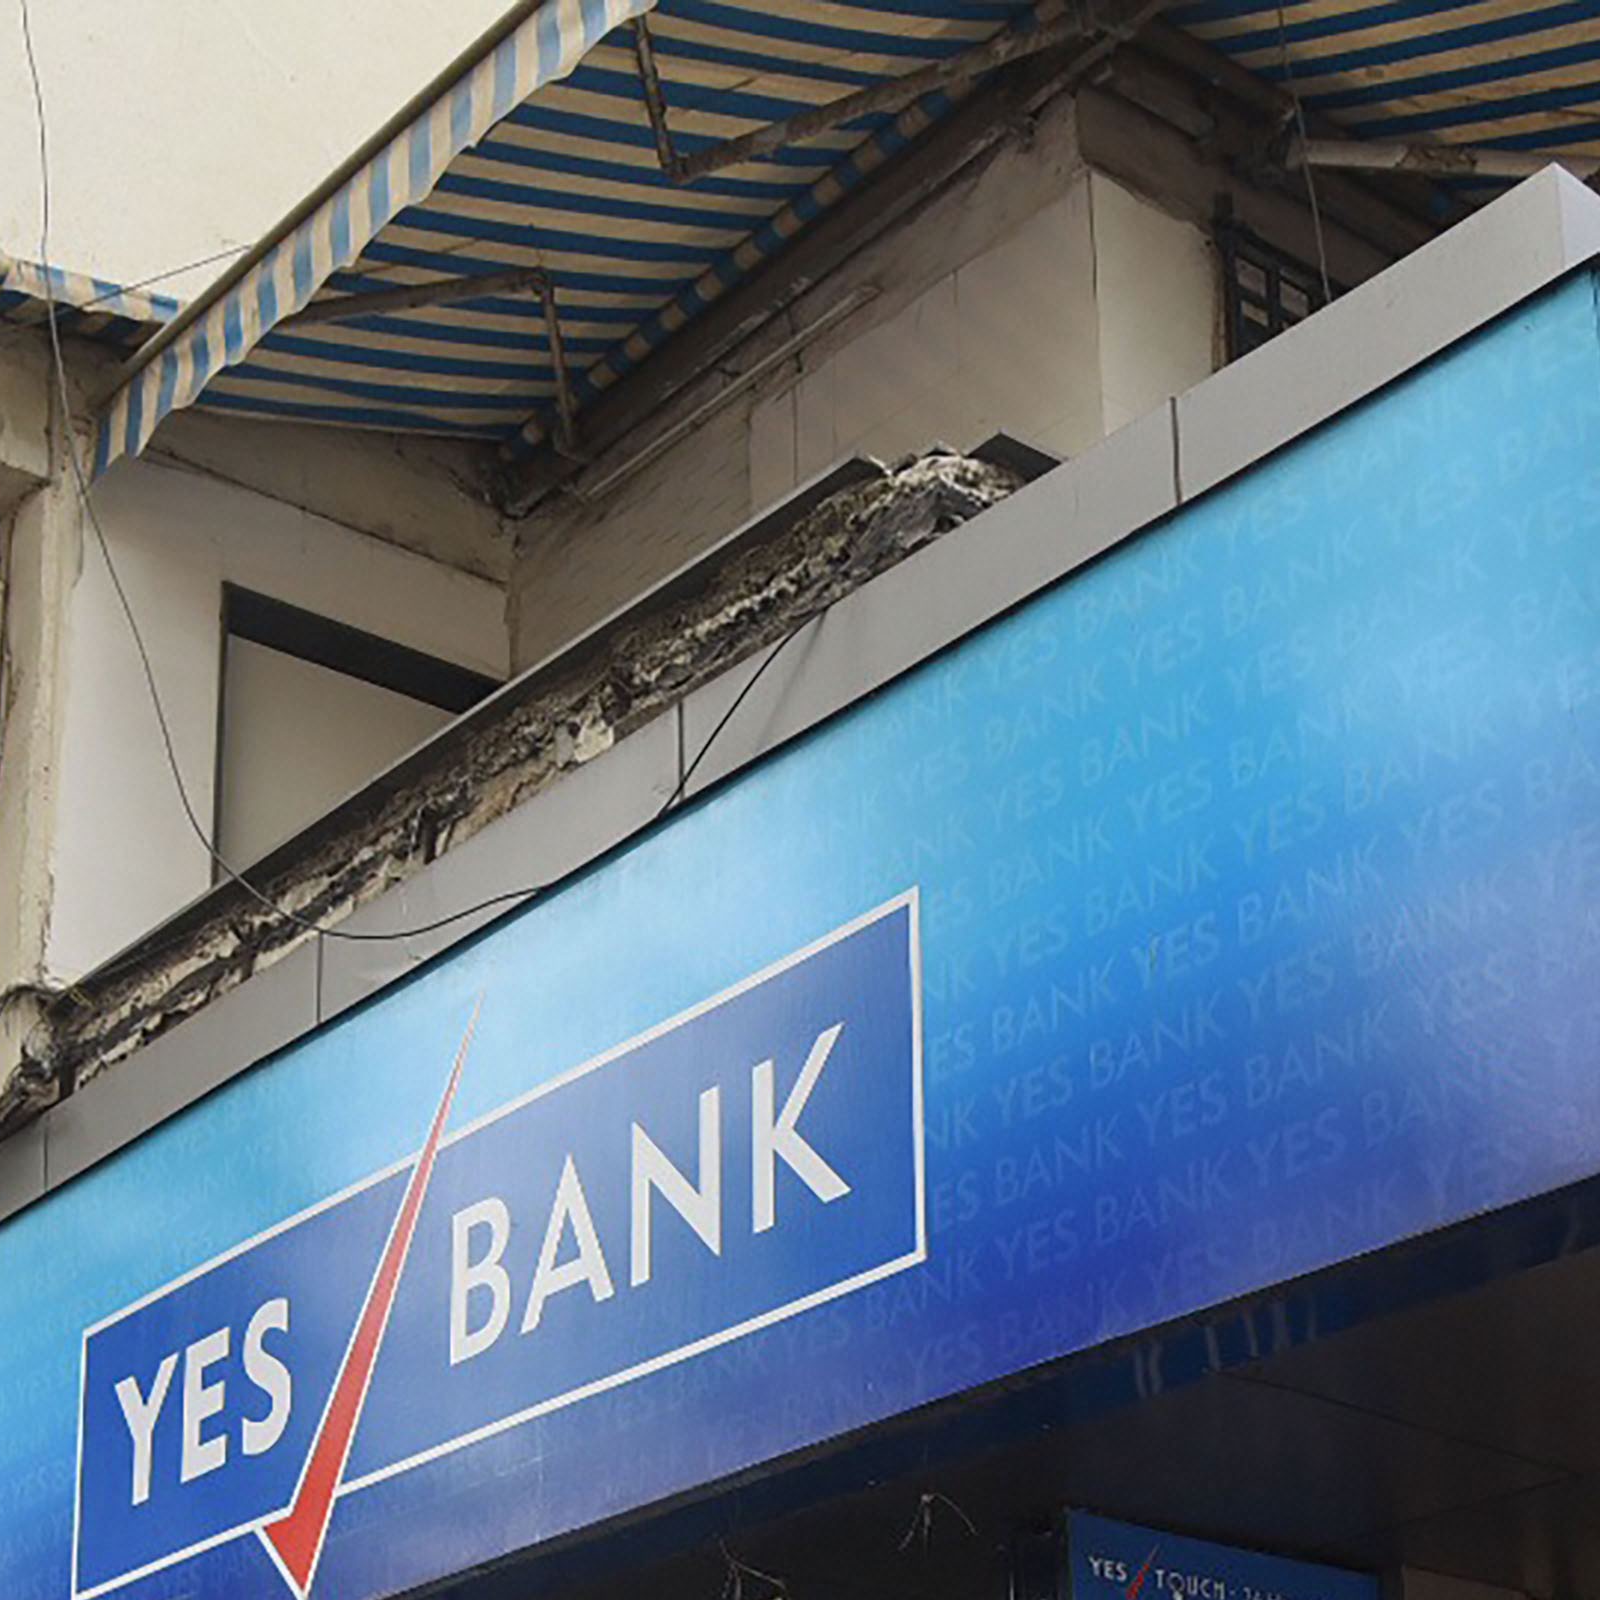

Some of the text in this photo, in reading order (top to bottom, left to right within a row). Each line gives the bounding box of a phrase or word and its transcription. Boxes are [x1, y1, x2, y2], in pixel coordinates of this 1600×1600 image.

[114, 1022, 852, 1508] YES BANK
[1088, 1555, 1128, 1582] YES
